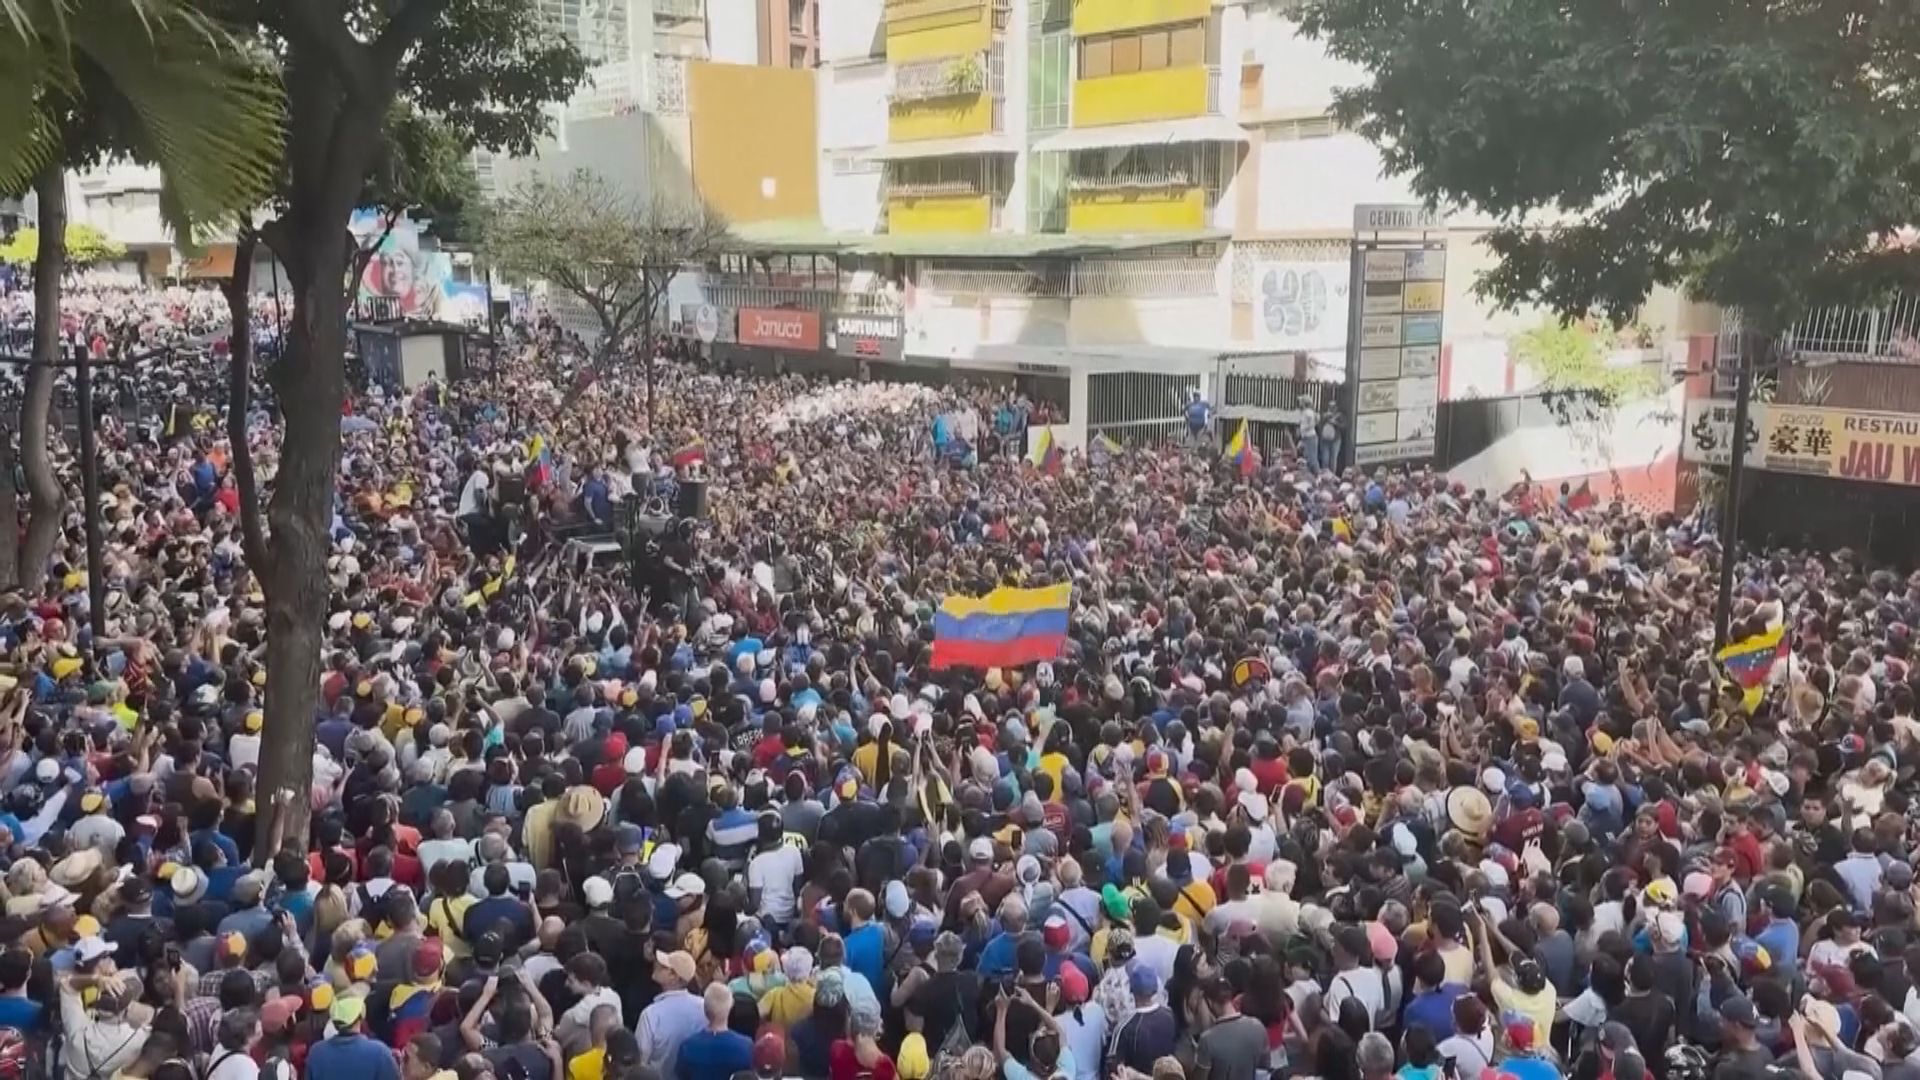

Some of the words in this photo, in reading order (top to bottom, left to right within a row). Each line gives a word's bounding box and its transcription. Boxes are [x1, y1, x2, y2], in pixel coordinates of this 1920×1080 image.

[1369, 209, 1412, 228] CENTRO
[753, 315, 803, 339] Janucá
[1844, 417, 1919, 436] RESTAU
[1839, 440, 1894, 480] JAU
